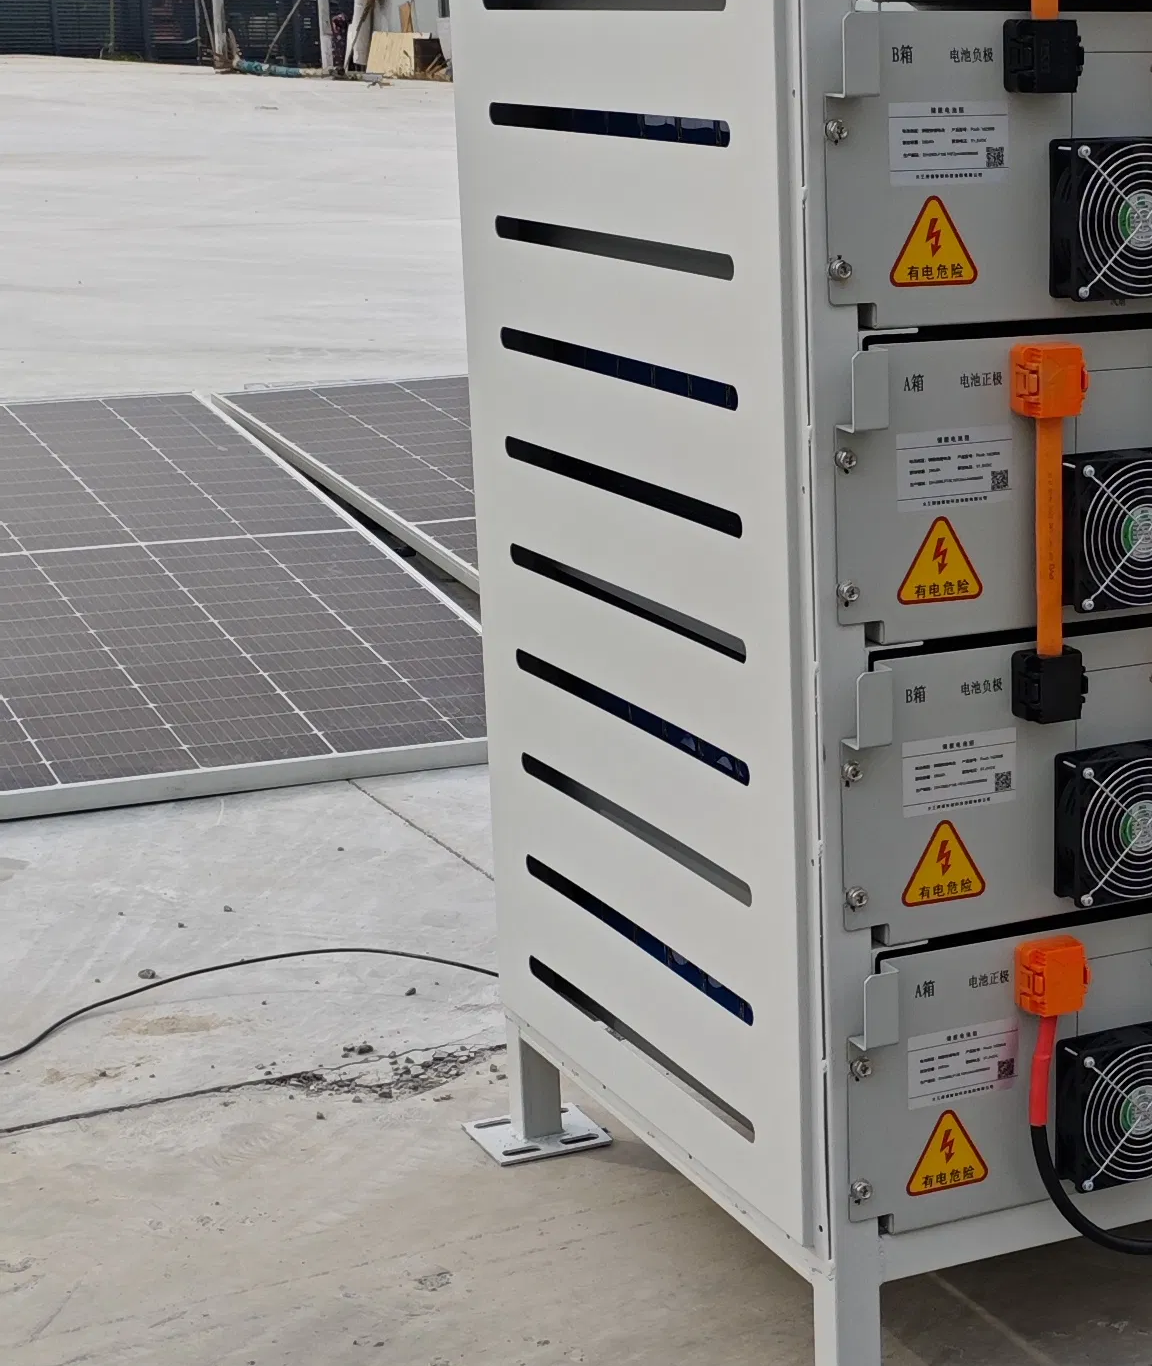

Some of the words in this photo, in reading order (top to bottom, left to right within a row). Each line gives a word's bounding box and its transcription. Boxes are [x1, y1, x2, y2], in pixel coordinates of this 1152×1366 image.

[892, 45, 913, 64] B箱
[950, 47, 994, 63] 电池负极
[908, 263, 964, 280] 有电危险
[904, 374, 924, 392] A箱
[960, 372, 1002, 388] 电池正极
[915, 579, 970, 598] 有电危险
[906, 685, 926, 703] B箱
[961, 678, 1003, 695] 电池负极
[919, 878, 973, 899] 有电危险
[969, 970, 1009, 988] 电池正极
[915, 980, 935, 998] A箱
[922, 1165, 975, 1188] 有电危险
